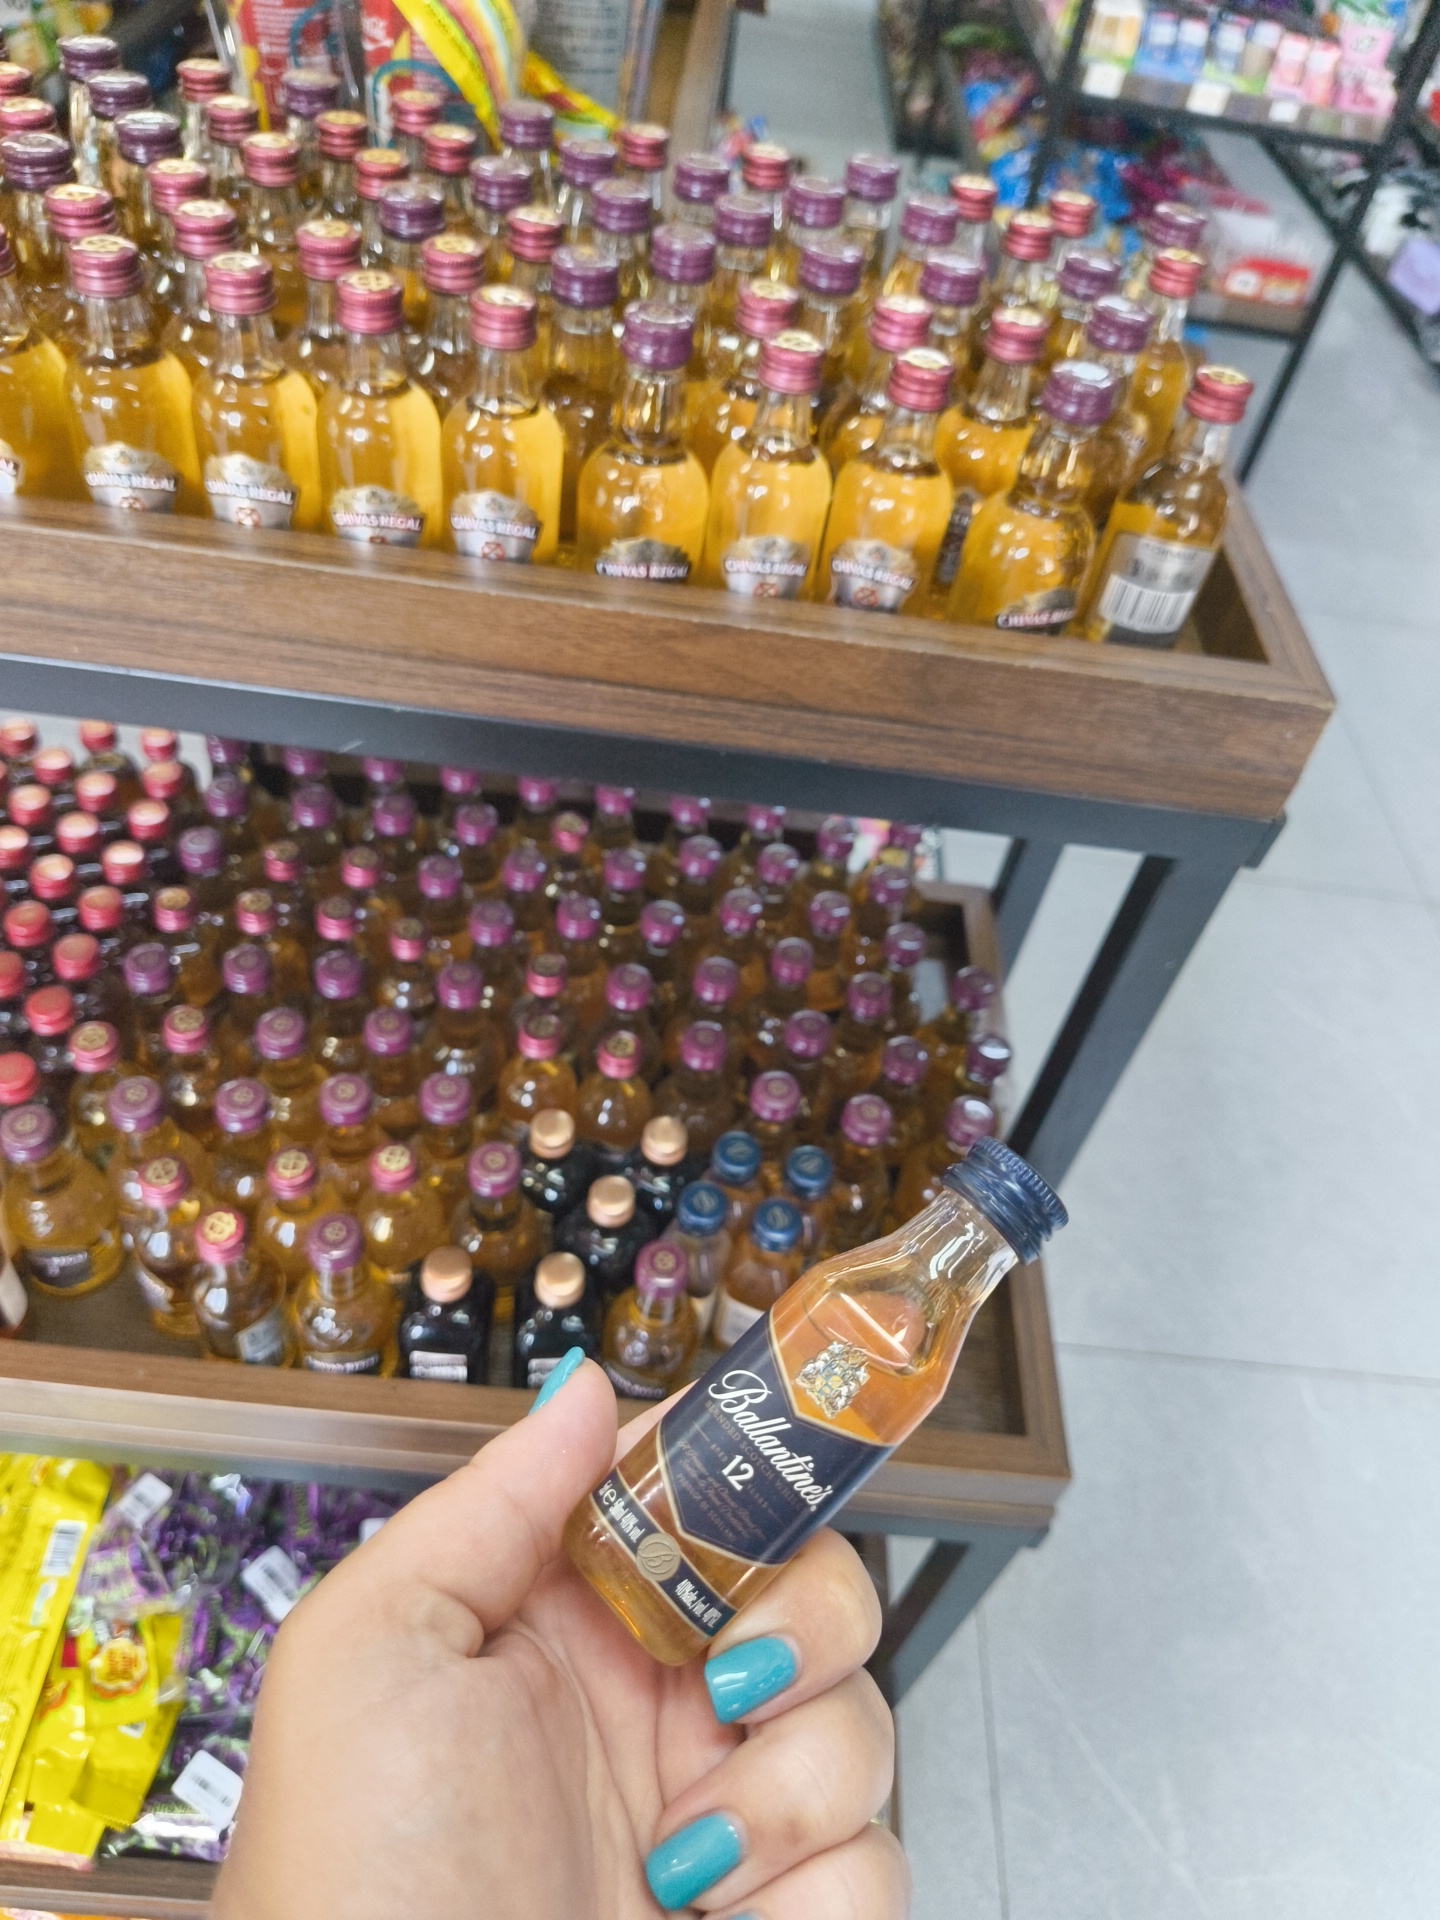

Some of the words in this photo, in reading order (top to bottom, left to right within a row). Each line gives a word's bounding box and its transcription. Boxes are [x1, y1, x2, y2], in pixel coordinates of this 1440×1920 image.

[333, 512, 379, 527] CHIVAS
[380, 514, 421, 531] REGAL
[451, 515, 495, 533] CHIVAS
[495, 519, 536, 540] REGAL
[725, 559, 771, 574] CHIVAS
[703, 1400, 741, 1441] BLENDED
[739, 1440, 775, 1479] SCOTCH
[708, 1369, 834, 1505] Ballantine's
[721, 1454, 754, 1491] 12
